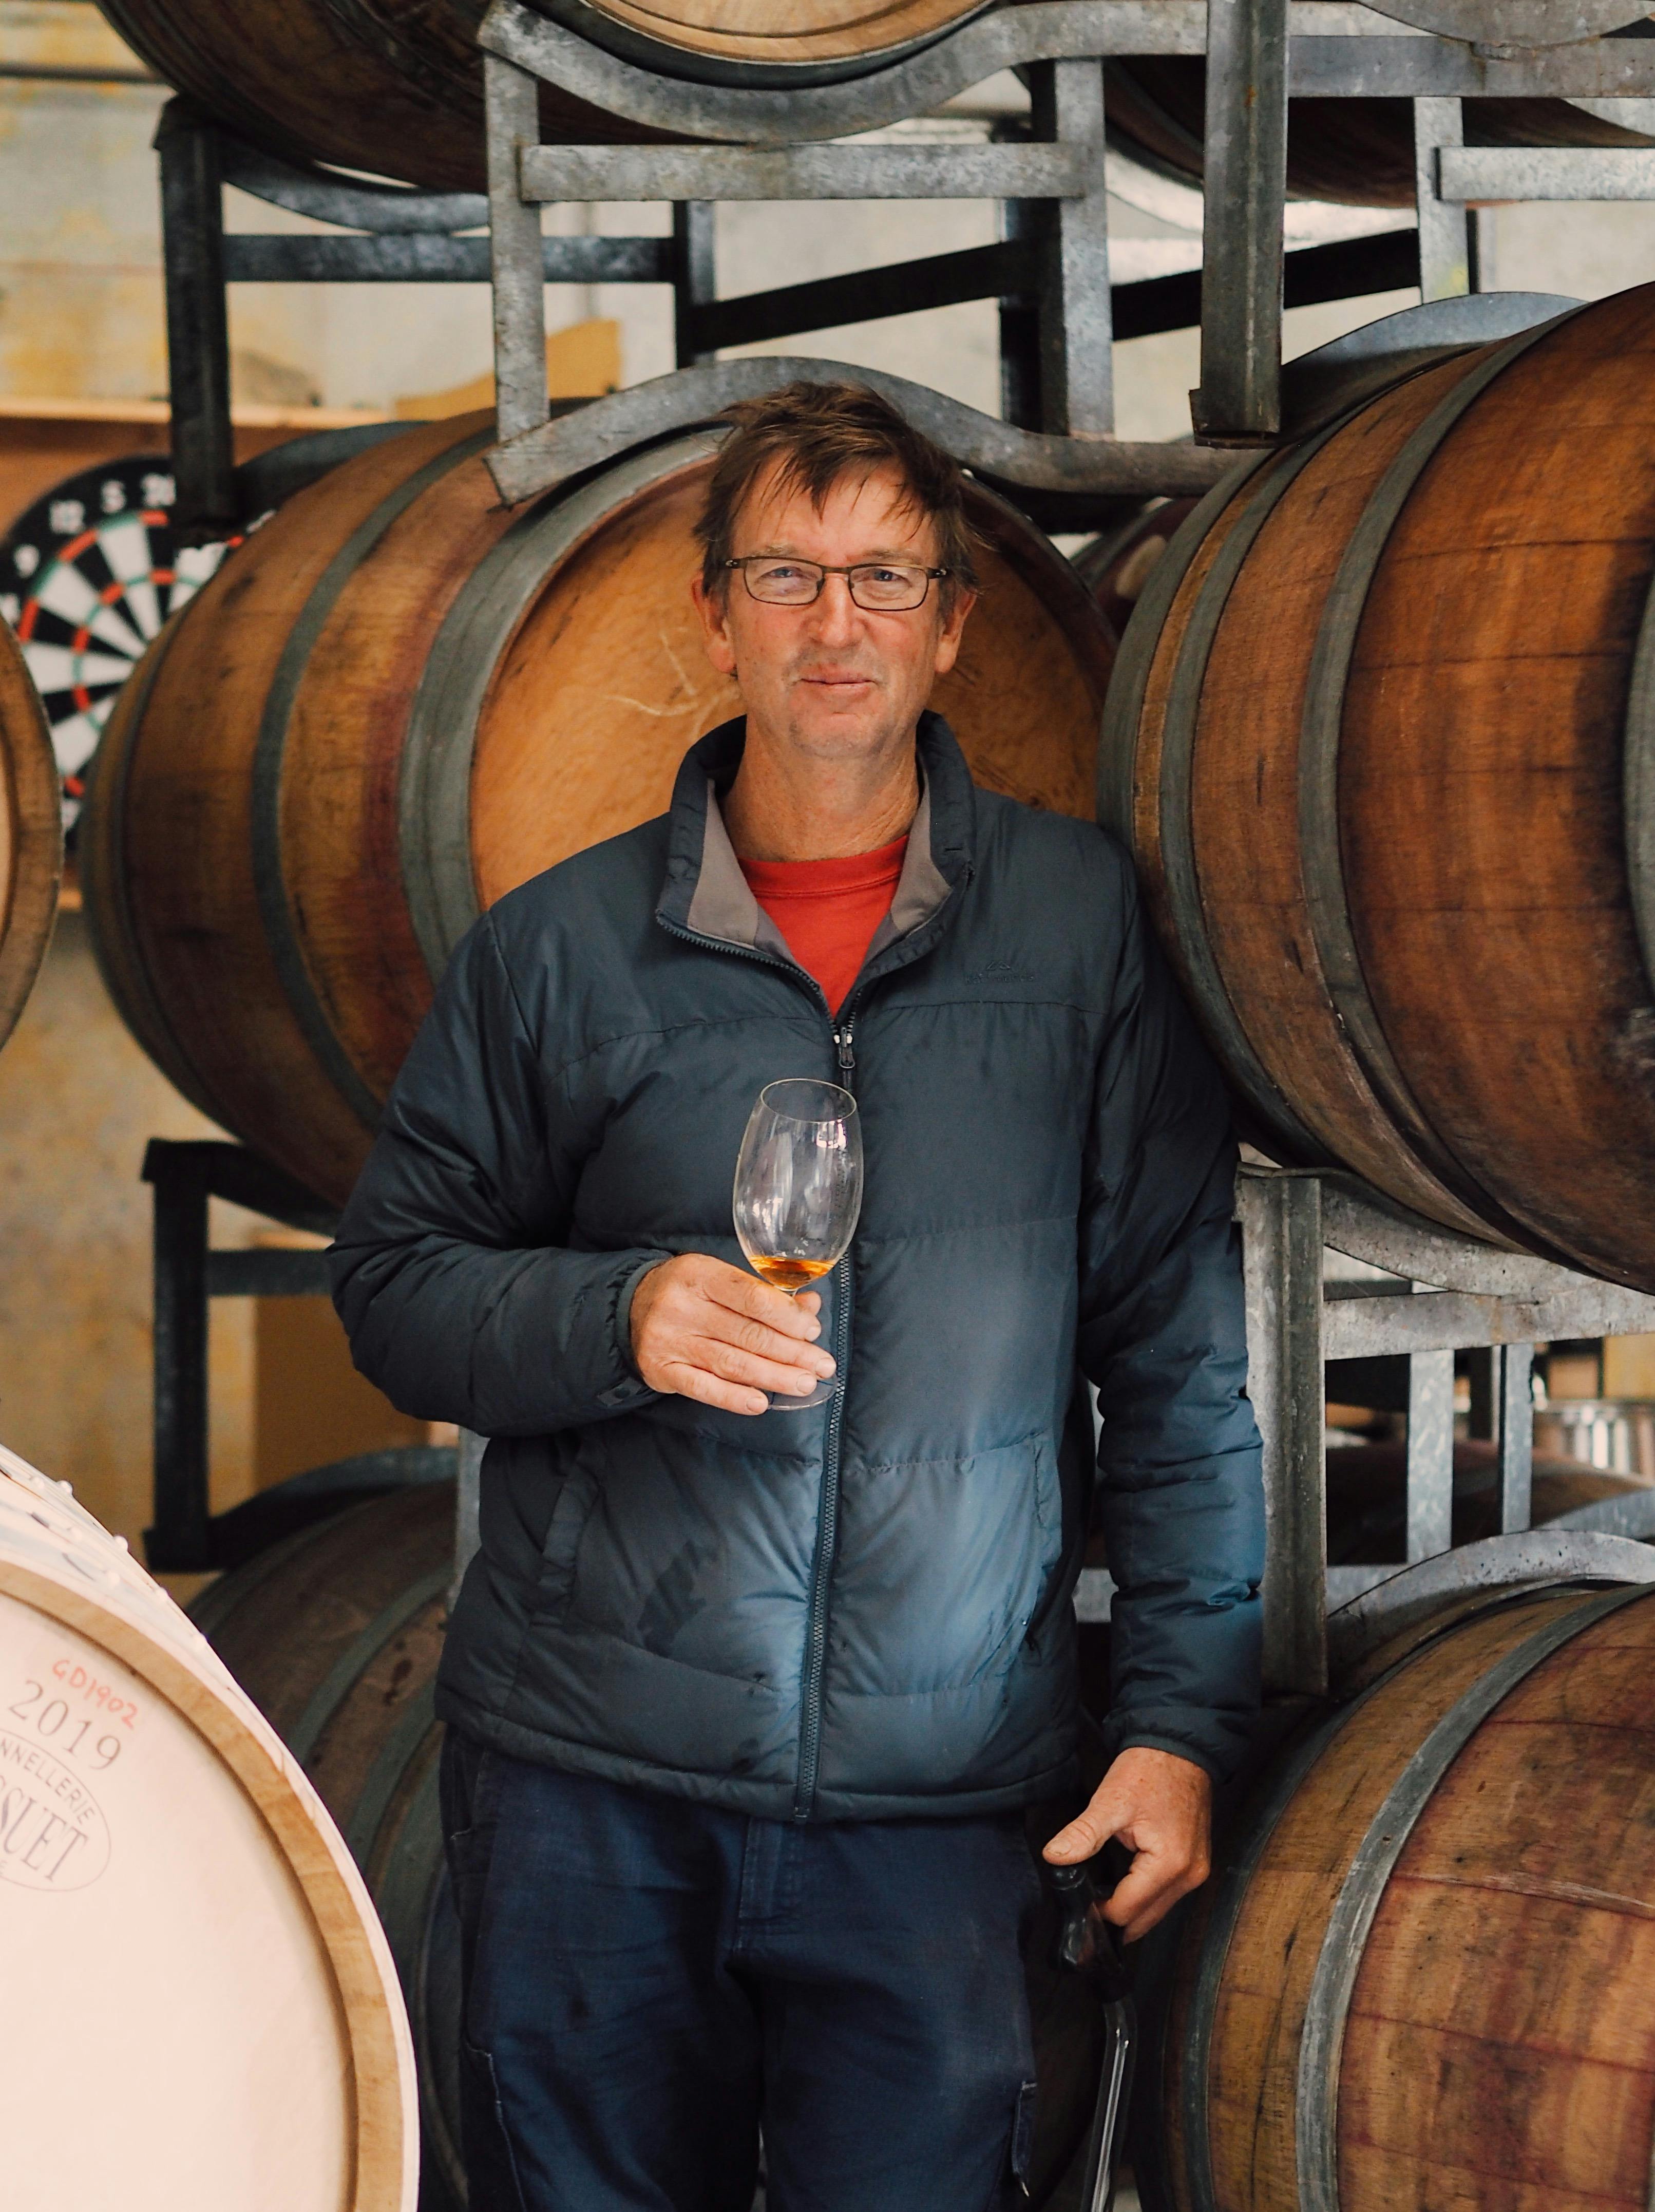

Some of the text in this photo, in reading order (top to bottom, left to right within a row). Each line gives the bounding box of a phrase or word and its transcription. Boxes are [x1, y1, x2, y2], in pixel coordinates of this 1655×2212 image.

[9, 1680, 121, 1770] 2019
[52, 1659, 138, 1730] GD1902
[0, 1774, 89, 1882] SUET
